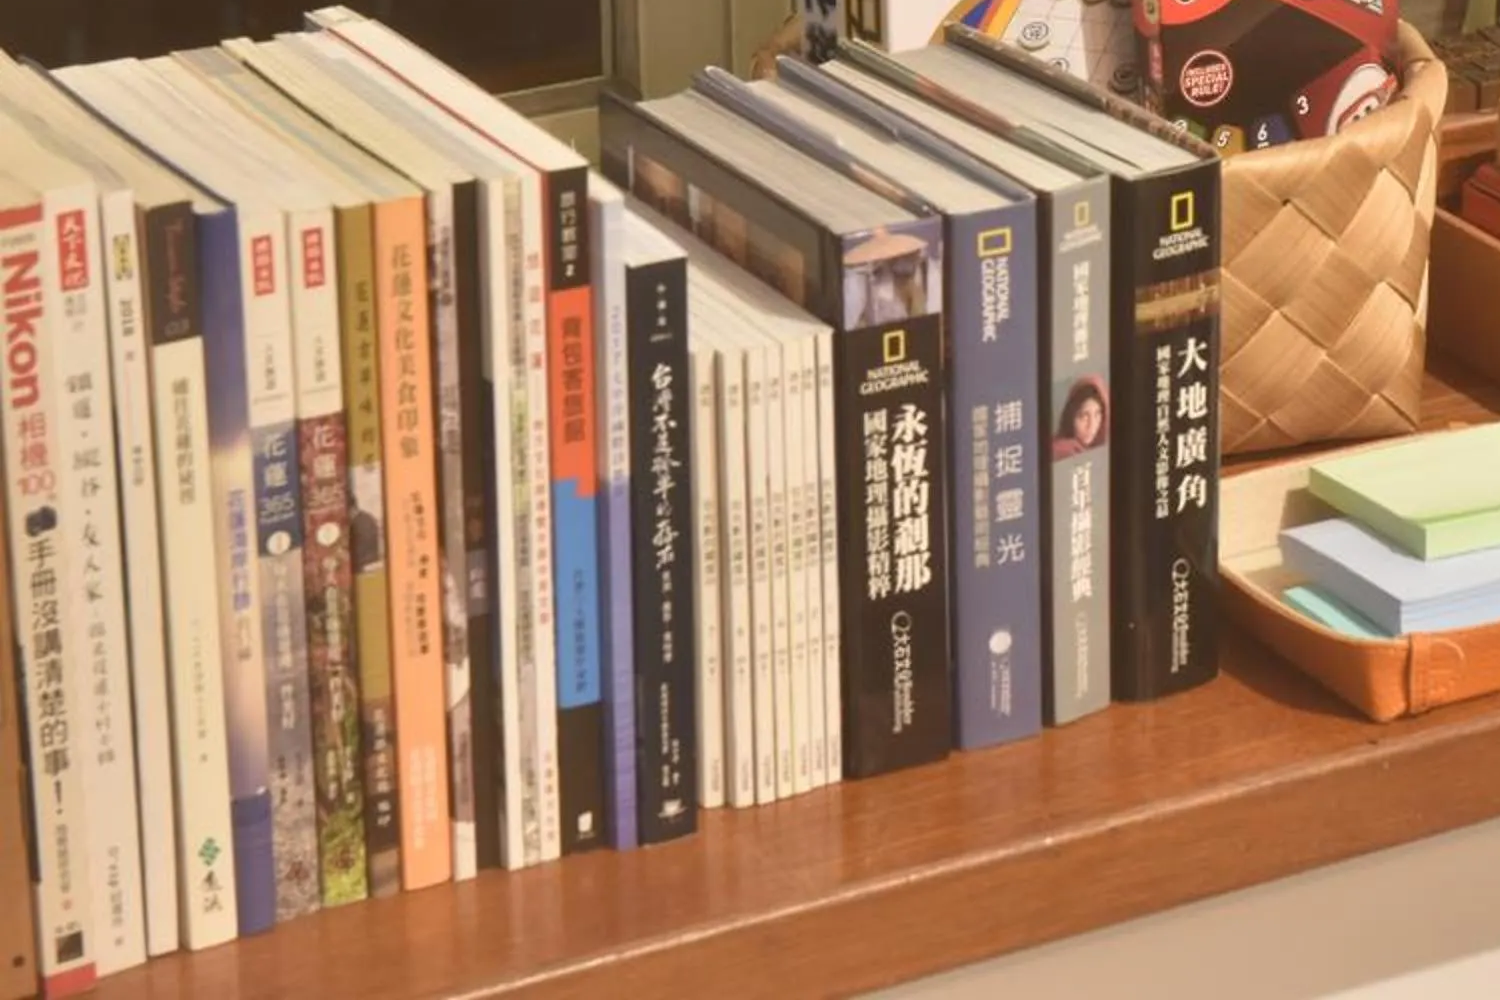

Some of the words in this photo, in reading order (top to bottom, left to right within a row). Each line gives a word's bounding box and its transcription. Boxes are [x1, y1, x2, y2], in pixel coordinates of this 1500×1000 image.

[1185, 73, 1229, 88] SPECIAL
[1153, 235, 1210, 261] GEOGRAPHIC
[1159, 228, 1203, 247] NATIONAL
[980, 257, 997, 343] GEOGRAPHIC
[996, 257, 1010, 323] NATIONAL
[2, 251, 42, 408] Nikon
[859, 369, 930, 396] GEOGRAPHIC
[867, 359, 921, 380] NATIONAL
[1176, 337, 1208, 514] 大地廣角
[863, 407, 891, 601] 國家地理攝影精粹
[994, 400, 1026, 566] 捕捉靈光
